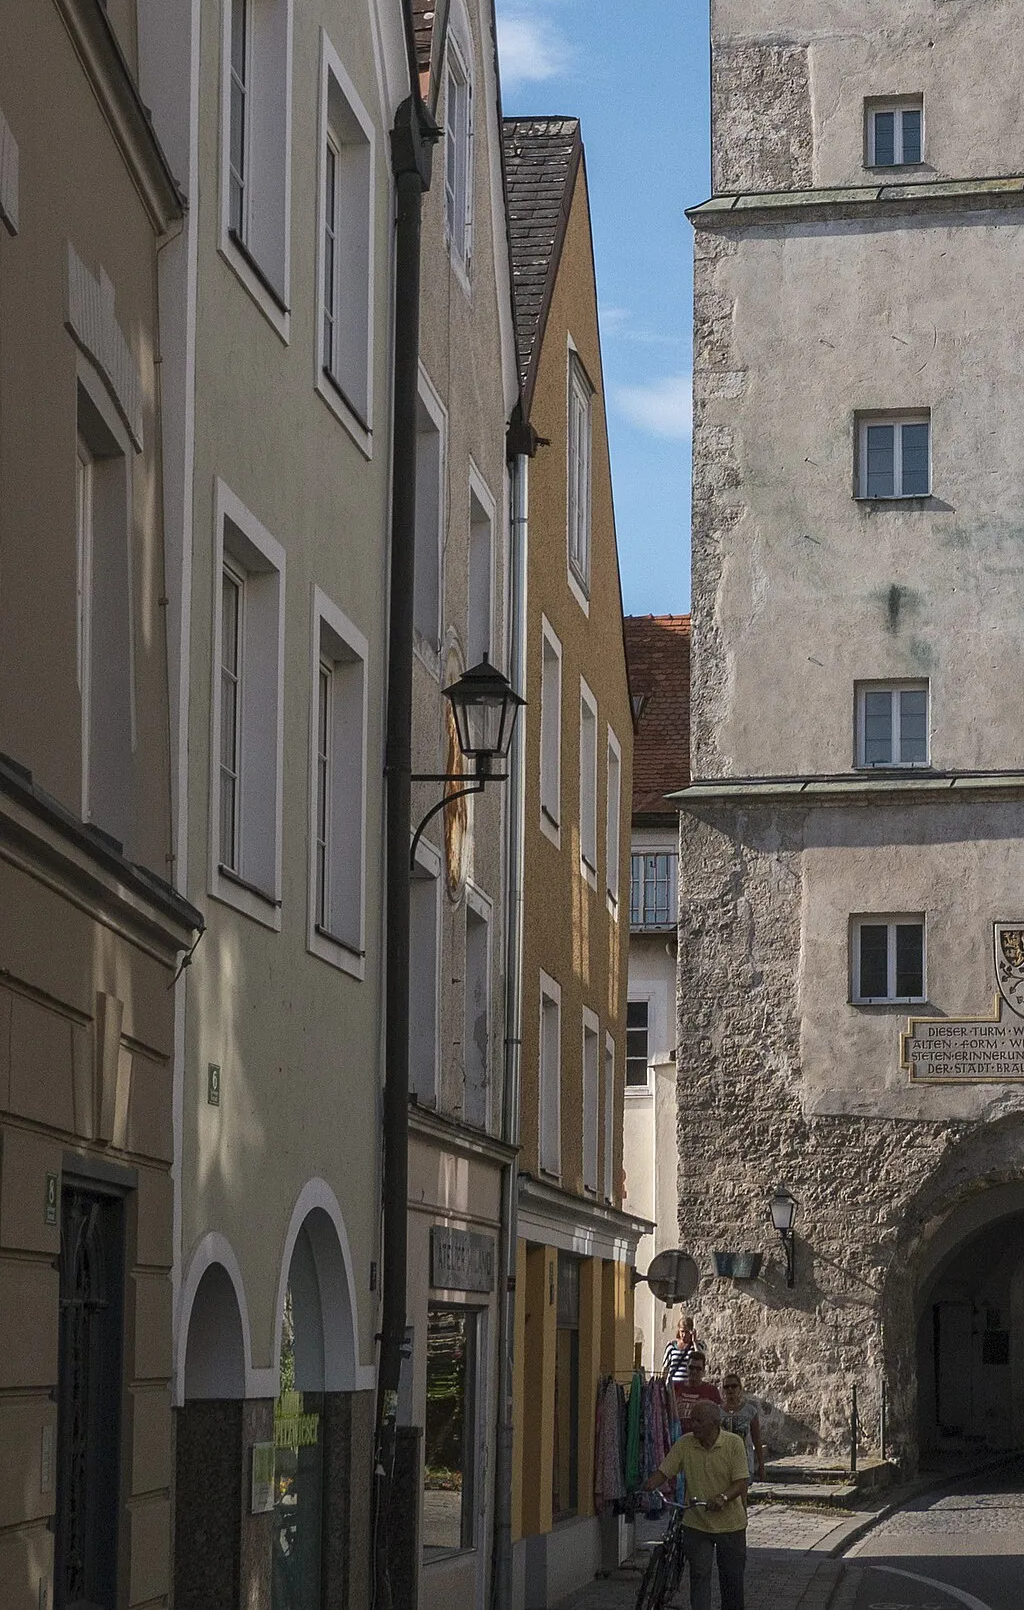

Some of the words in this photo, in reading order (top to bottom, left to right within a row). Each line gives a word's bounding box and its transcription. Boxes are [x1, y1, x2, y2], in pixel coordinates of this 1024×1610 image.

[929, 1027, 967, 1036] DIESER
[972, 1027, 1006, 1036] TURM
[913, 1040, 952, 1049] ALTEN
[960, 1040, 997, 1049] FORM
[912, 1052, 952, 1061] STETEN
[928, 1064, 949, 1074] DER
[955, 1063, 992, 1073] STADT
